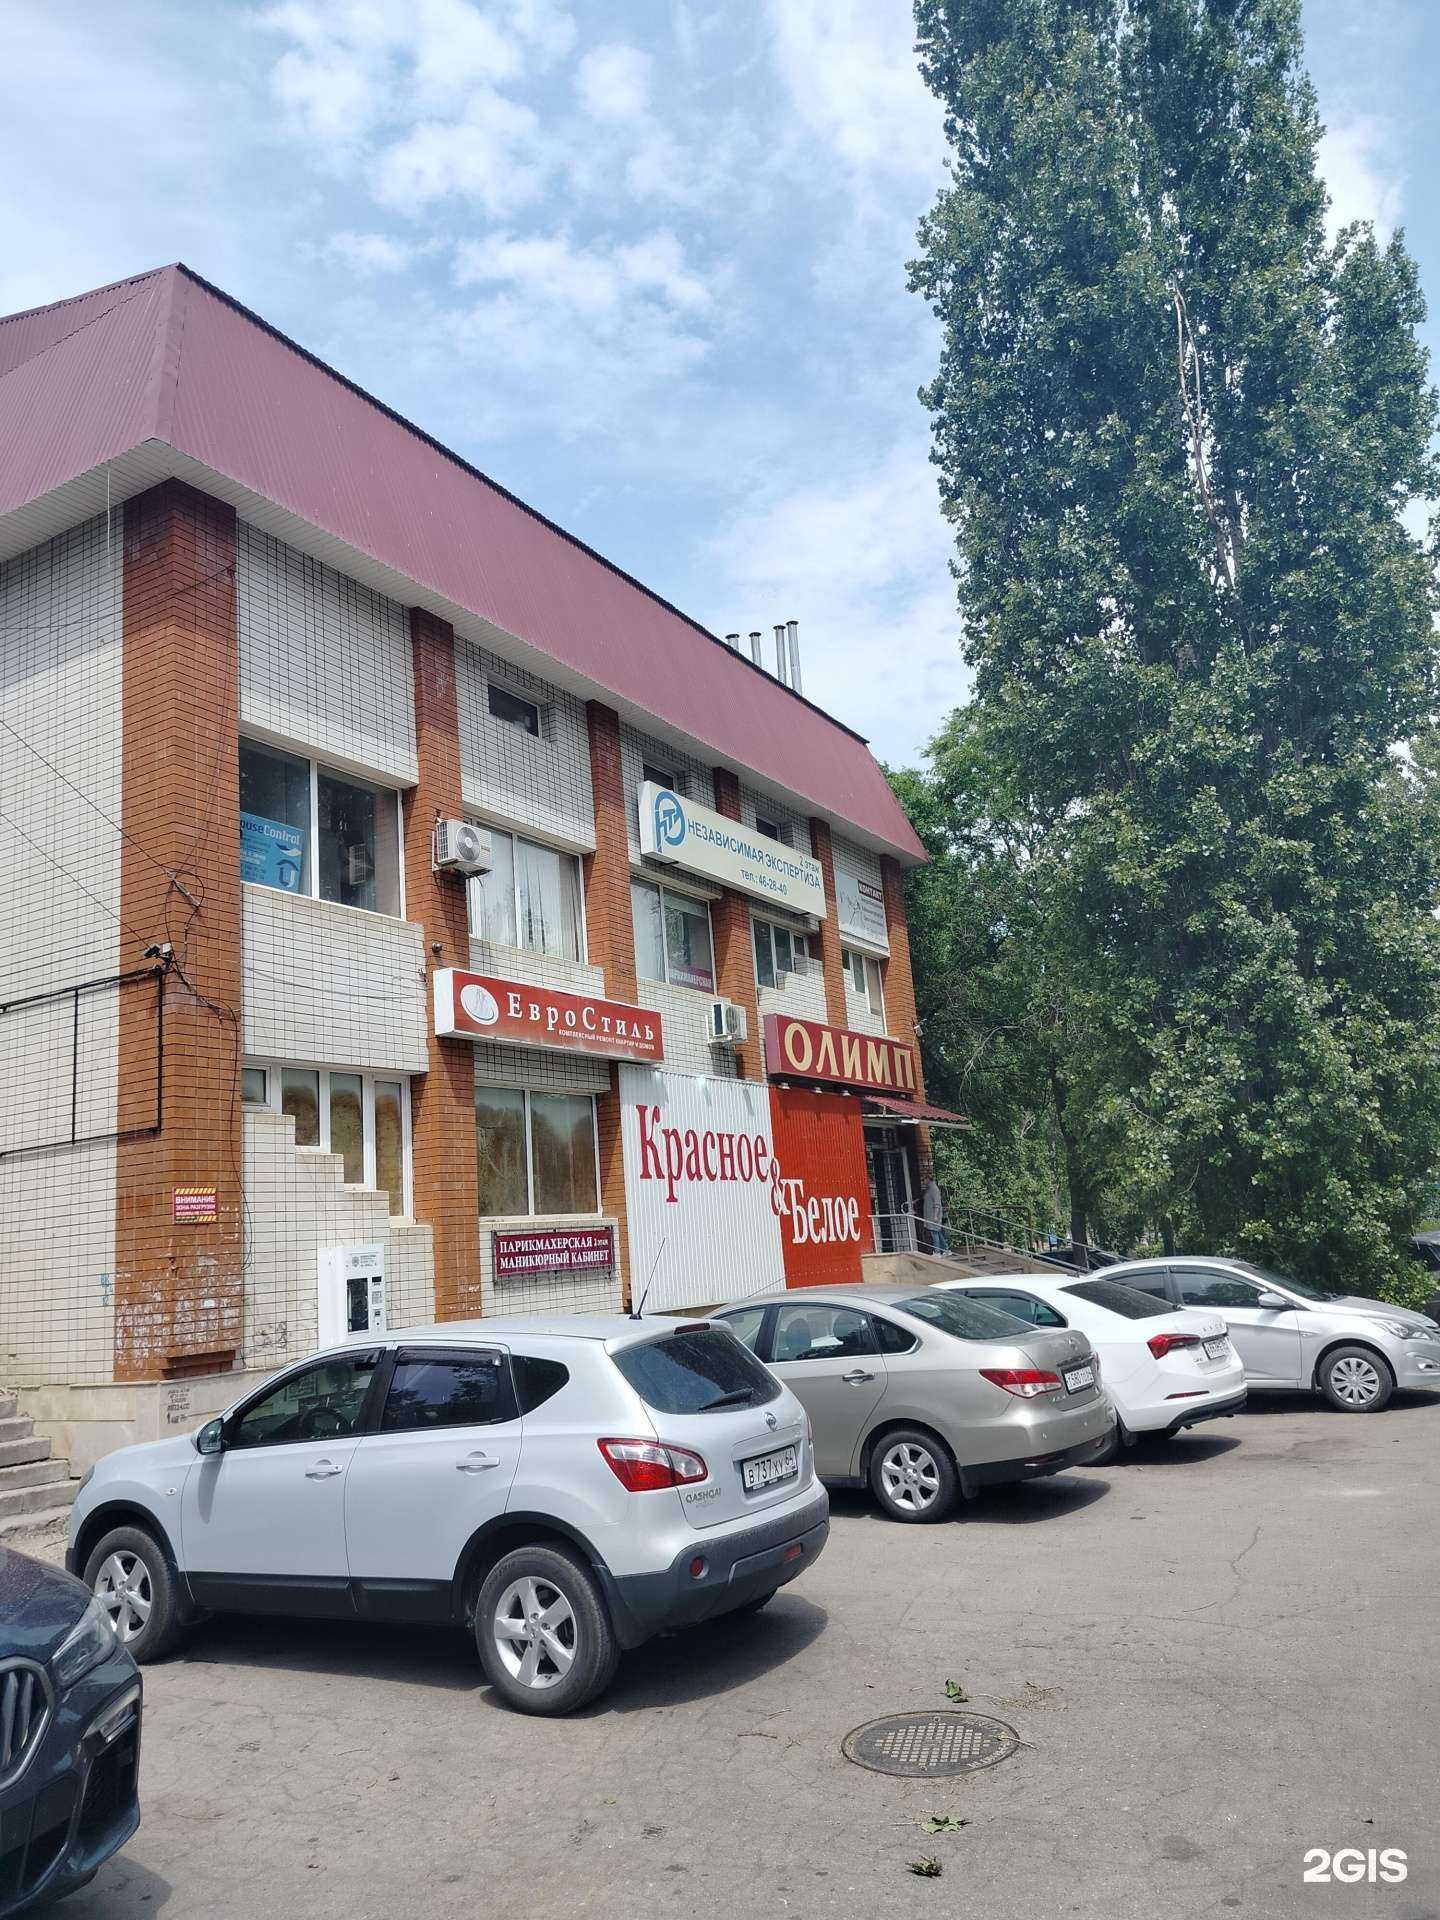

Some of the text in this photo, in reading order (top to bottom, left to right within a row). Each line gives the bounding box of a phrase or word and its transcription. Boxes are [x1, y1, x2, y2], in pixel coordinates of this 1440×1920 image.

[687, 818, 764, 866] НЕЗАВИСИМАЯ
[764, 852, 821, 890] ЭКСПЕРТИЗА
[758, 875, 788, 897] 46-28-40
[506, 991, 655, 1041] ЕвроСтиль
[784, 1022, 915, 1089] ОЛИМП
[636, 1104, 769, 1203] Красное
[175, 1195, 216, 1204] ВНИМАНИЕ
[783, 1178, 861, 1244] Белое
[500, 1236, 592, 1253] ПАРИКМАХЕРСКАЯ
[500, 1249, 609, 1269] МАНИКЮРНЫЙ КАБИНЕТ
[685, 1487, 722, 1504] QASHQAI
